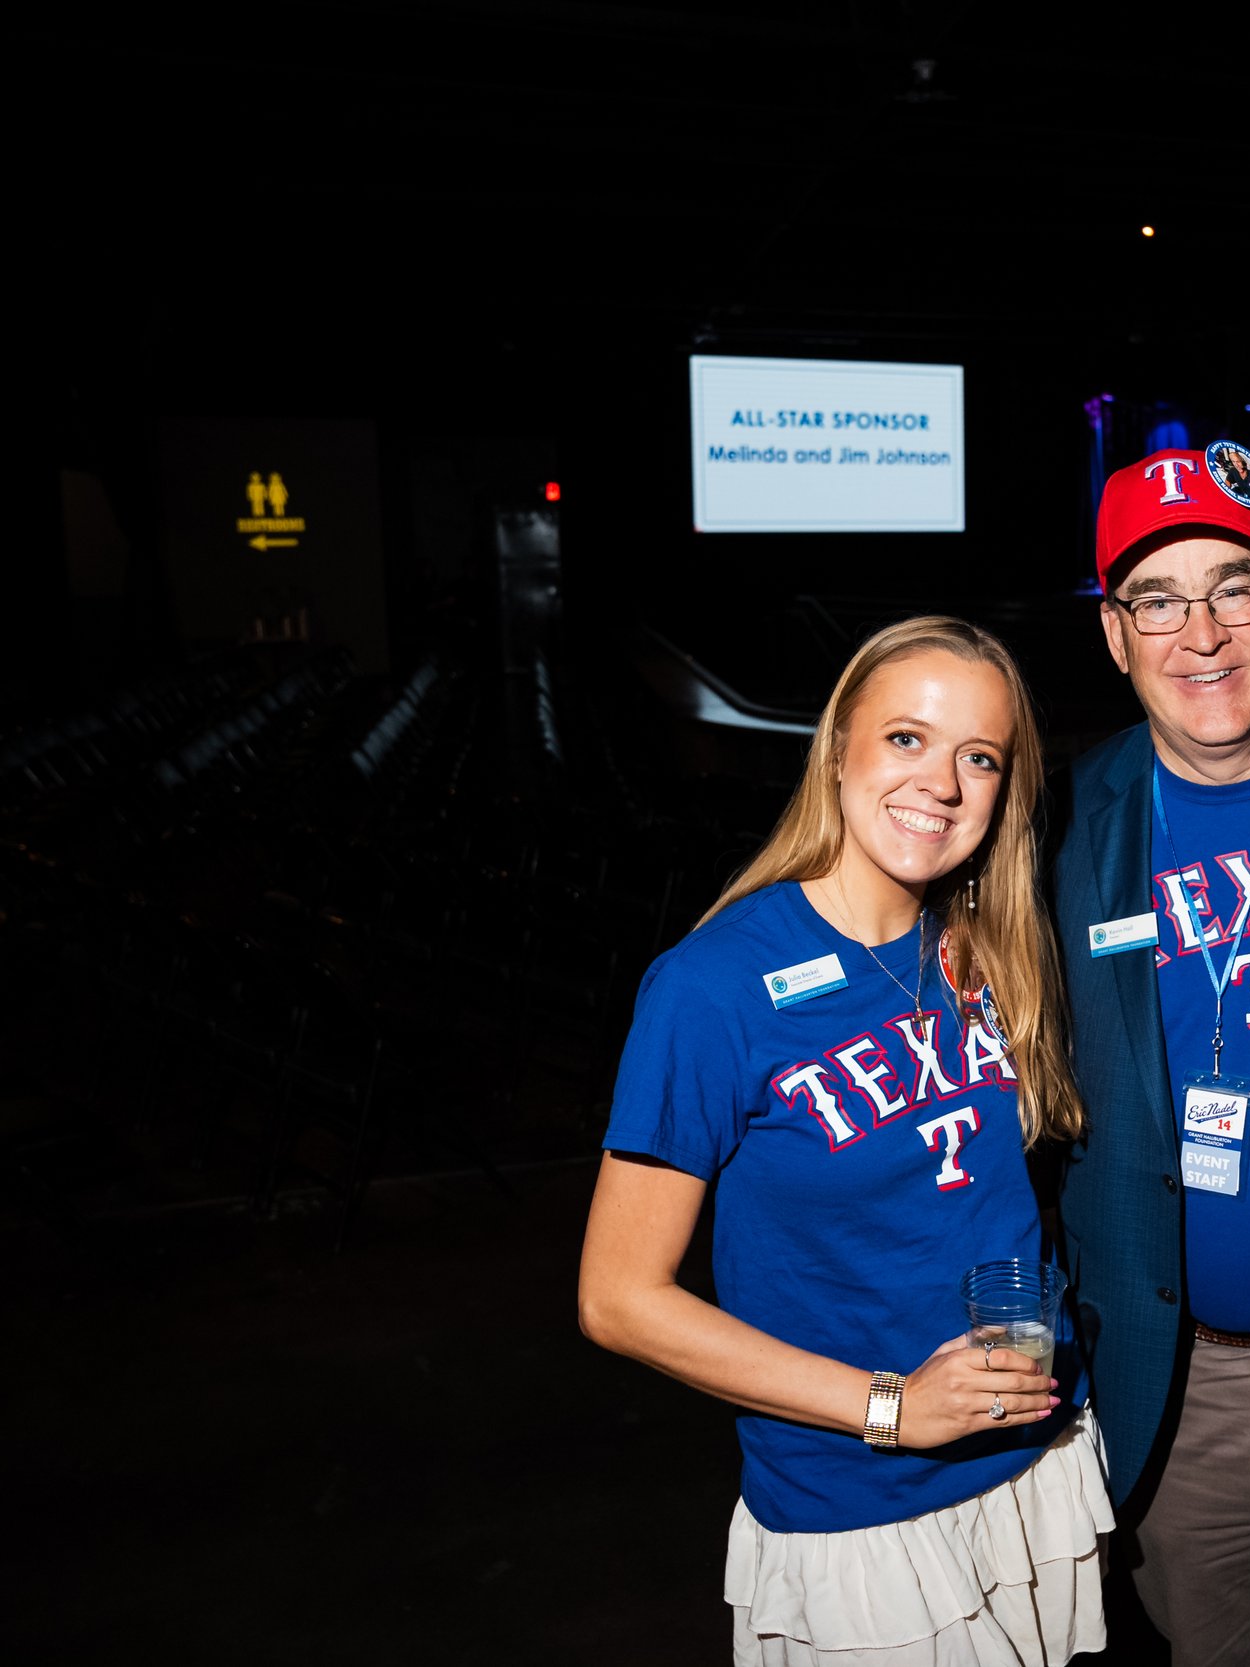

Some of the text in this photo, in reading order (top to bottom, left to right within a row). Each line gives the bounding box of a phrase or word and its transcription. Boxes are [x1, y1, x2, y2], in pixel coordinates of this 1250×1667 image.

[731, 409, 930, 431] ALL-STAR SPONSOR
[708, 446, 951, 466] Melinda and Jim Johnson
[1145, 458, 1199, 506] T
[771, 1010, 1018, 1153] TEXA
[1187, 1105, 1206, 1120] Eric
[1207, 1100, 1238, 1116] Nadel
[1218, 1119, 1231, 1131] 14
[1186, 1151, 1230, 1170] EVENT
[1186, 1170, 1226, 1188] STAFF
